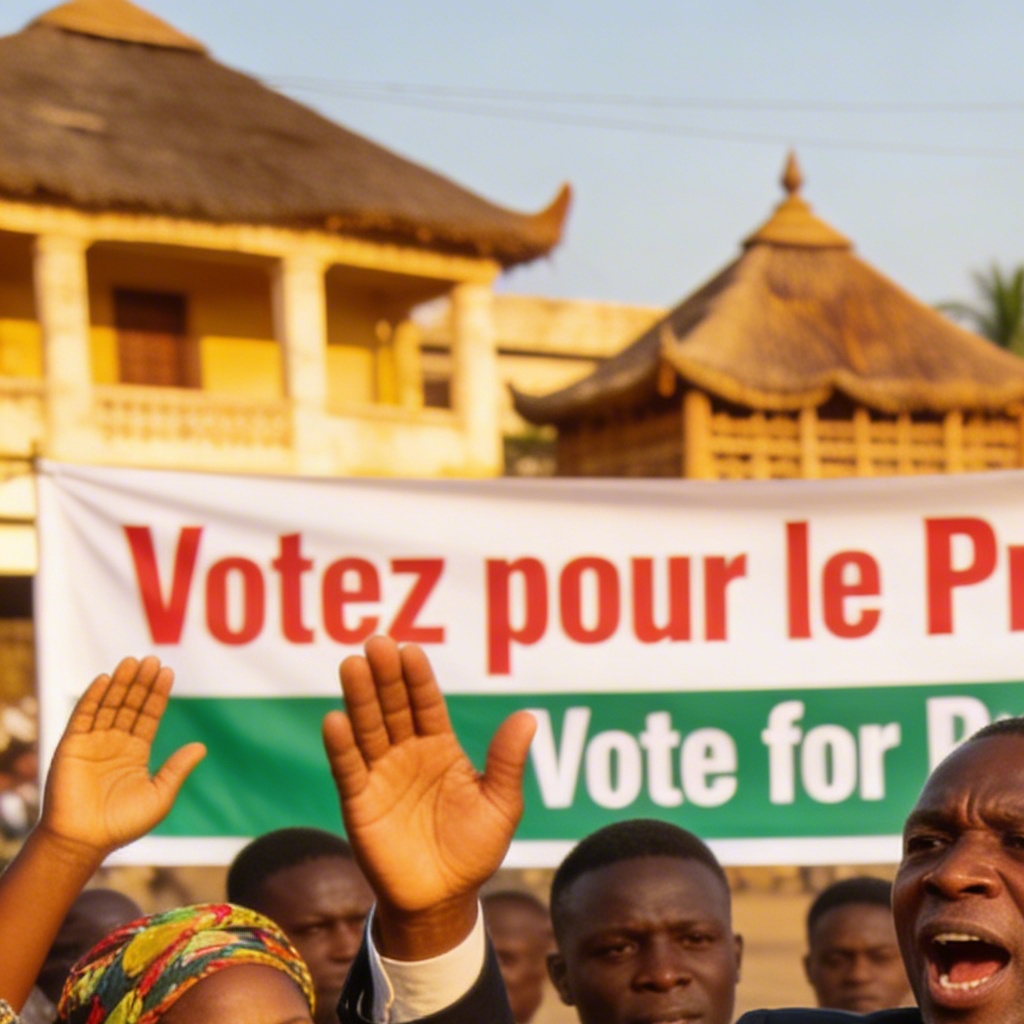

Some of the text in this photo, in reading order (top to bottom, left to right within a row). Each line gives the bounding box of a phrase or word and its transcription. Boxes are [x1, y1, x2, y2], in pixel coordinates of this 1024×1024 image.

[122, 525, 445, 646] Votez
[485, 553, 747, 675] pour
[786, 521, 881, 639] le
[526, 706, 738, 810] Vote
[761, 700, 900, 805] for
